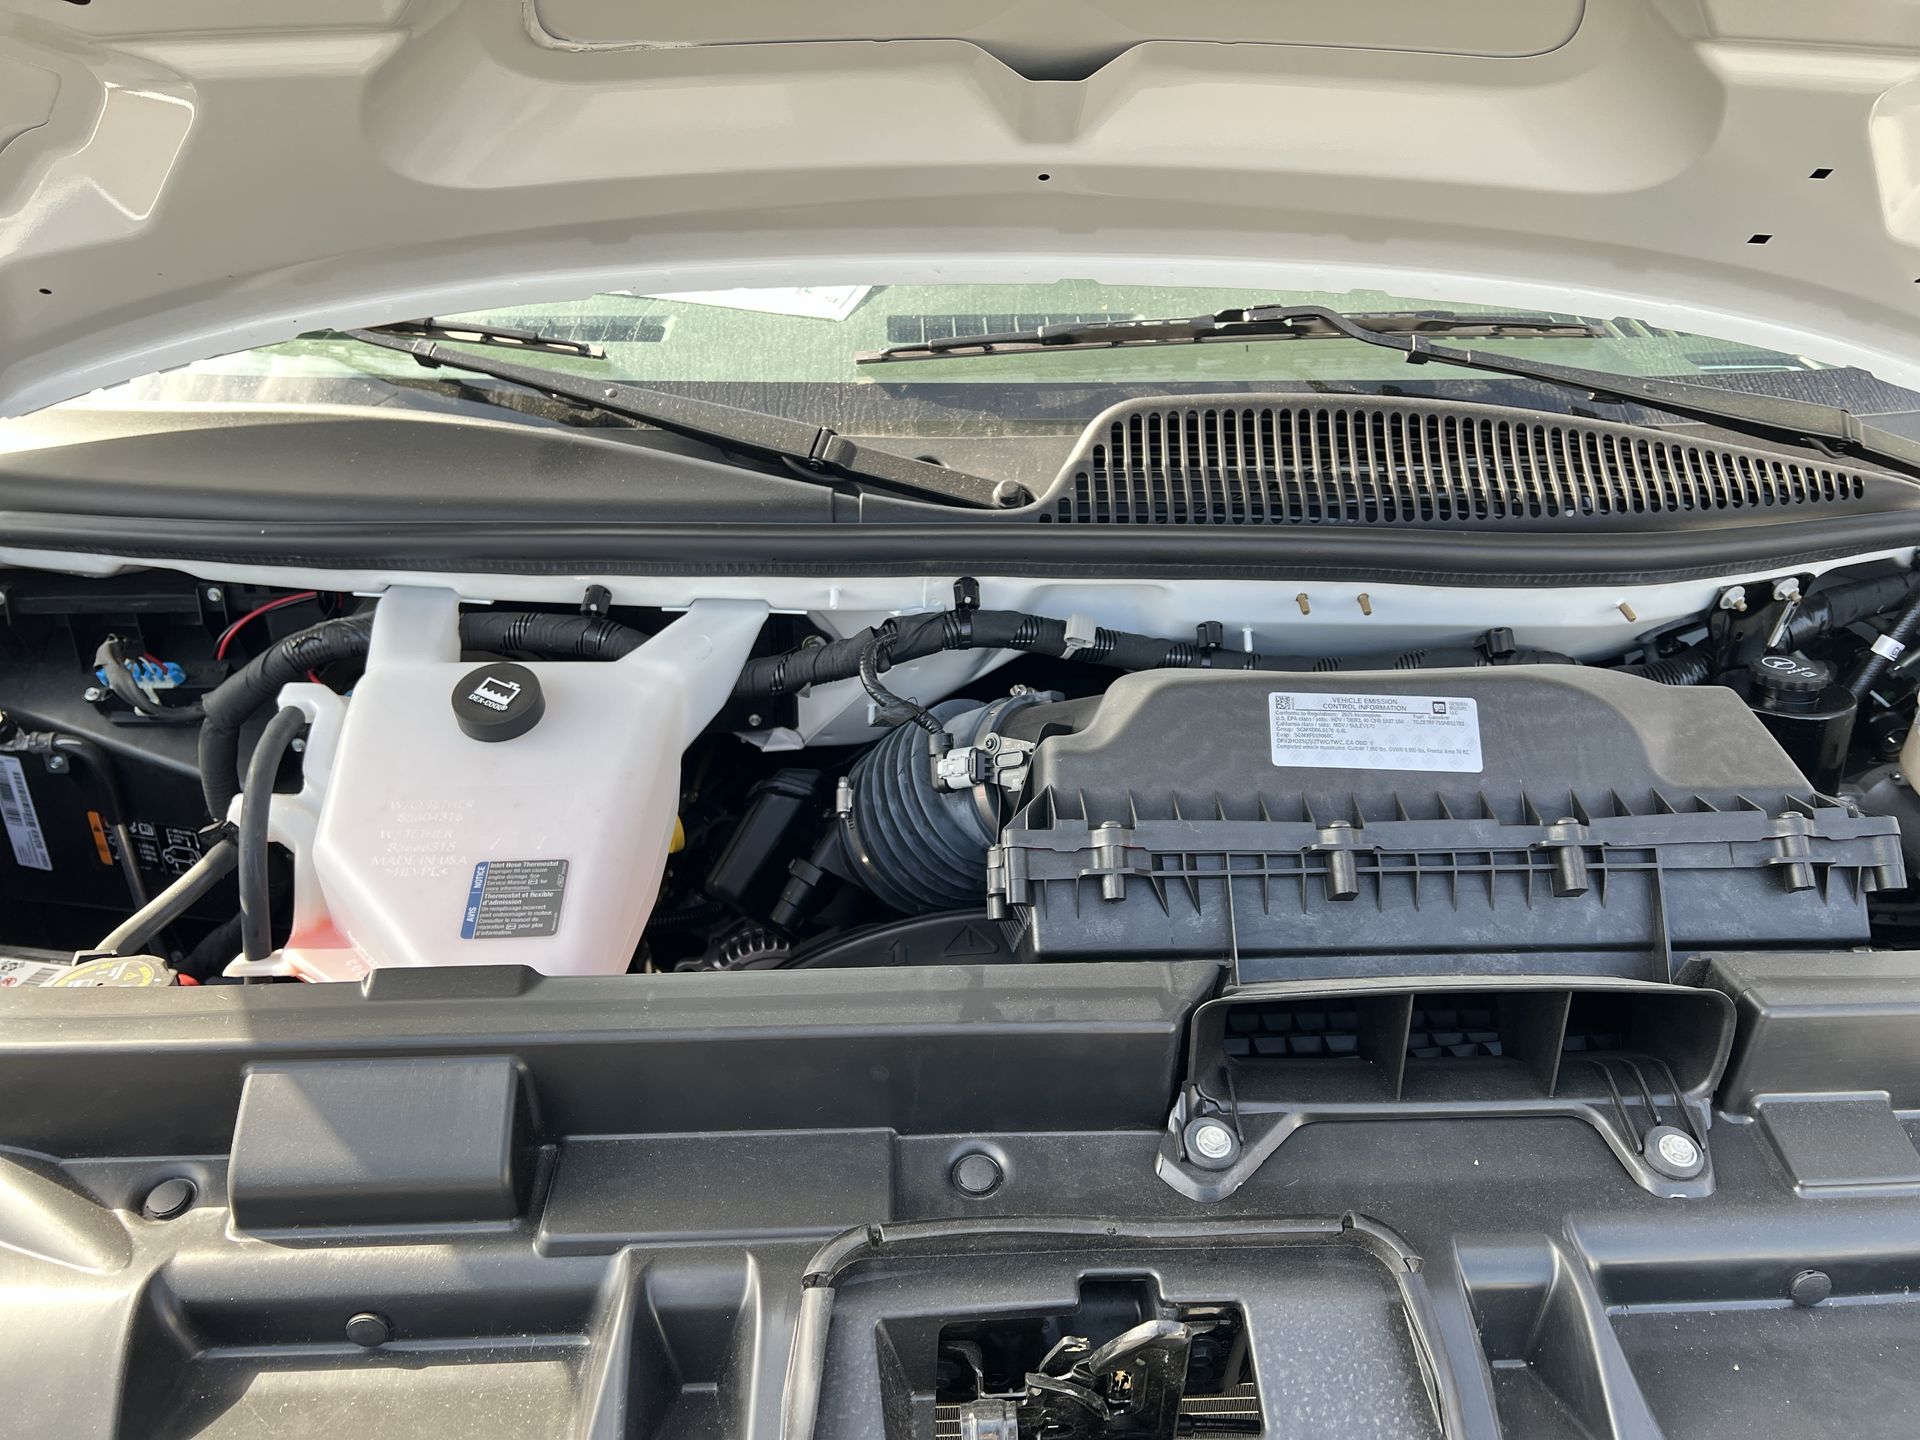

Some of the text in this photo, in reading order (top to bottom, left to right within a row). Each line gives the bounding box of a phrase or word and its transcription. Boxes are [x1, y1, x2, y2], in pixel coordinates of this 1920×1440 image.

[370, 856, 468, 866] MADE IN USA
[474, 865, 486, 889] NOTICE
[467, 907, 477, 922] AVIS
